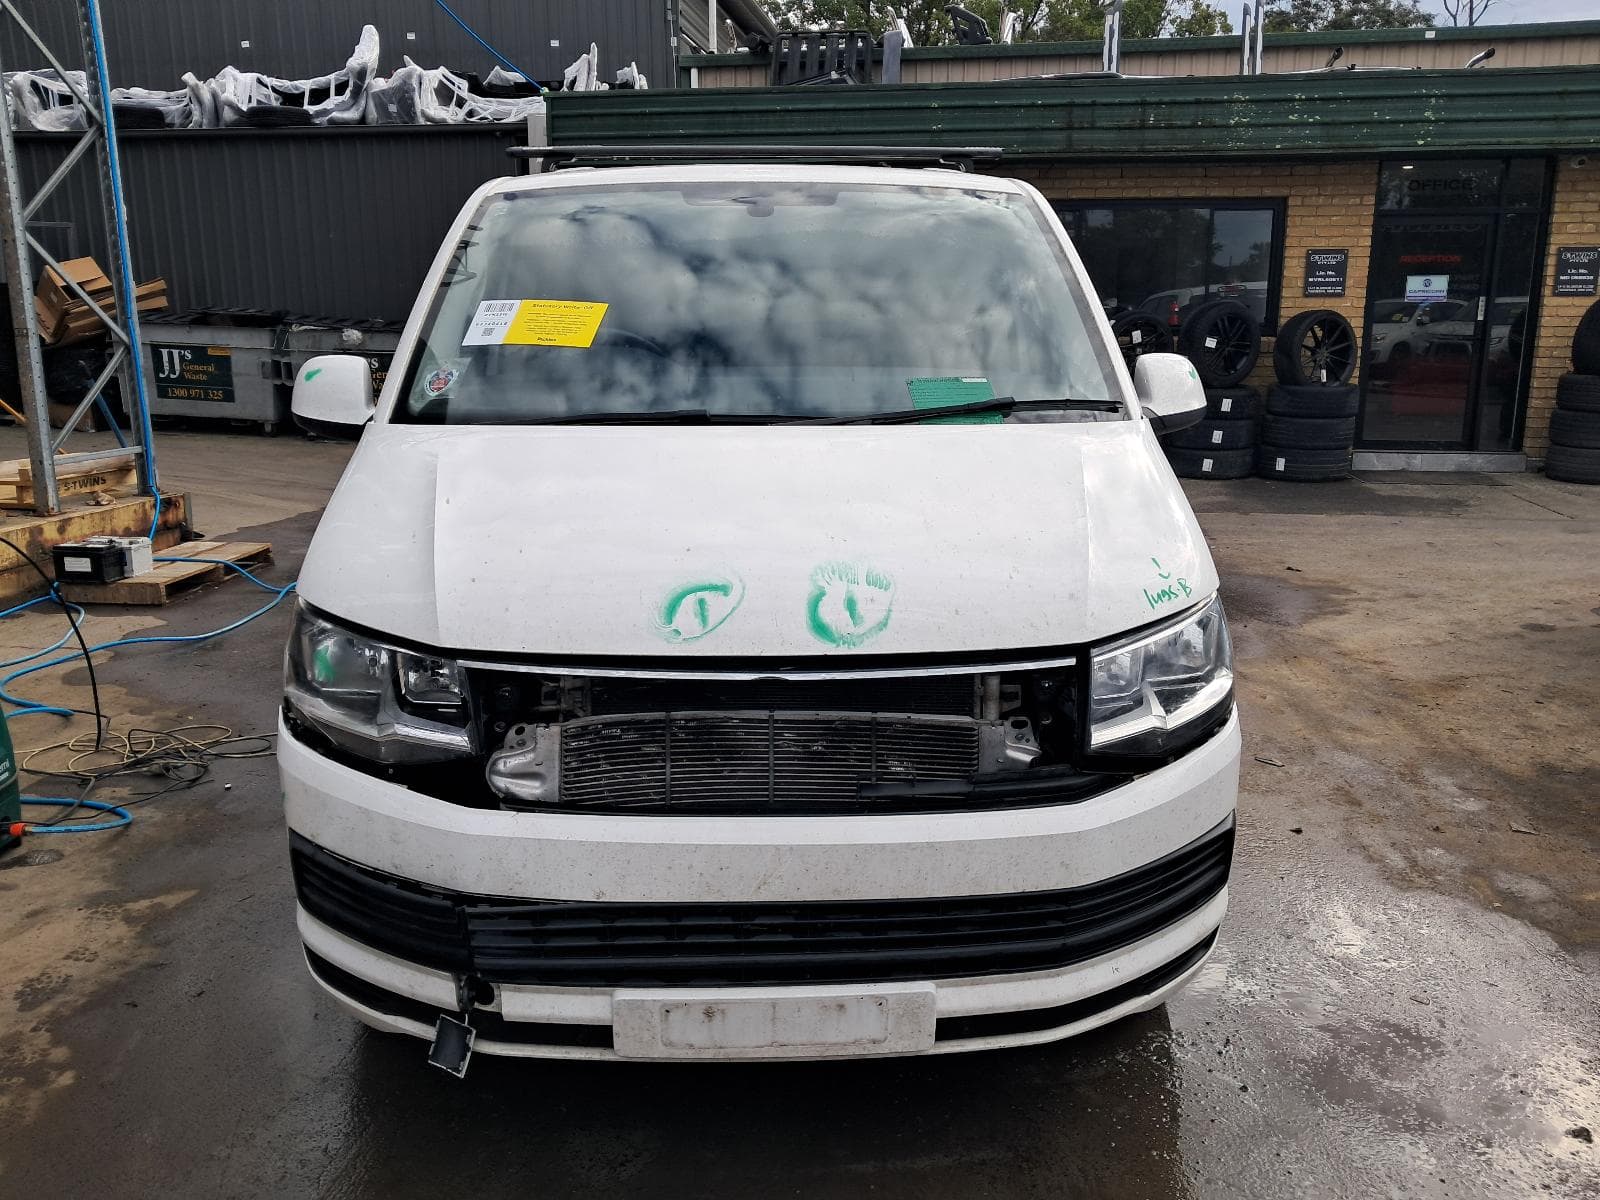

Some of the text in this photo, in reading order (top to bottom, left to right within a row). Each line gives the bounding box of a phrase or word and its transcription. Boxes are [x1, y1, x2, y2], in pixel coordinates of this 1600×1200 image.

[1408, 178, 1473, 192] OFFICE
[1399, 254, 1462, 264] RECEPTION
[182, 362, 215, 372] General
[183, 371, 208, 381] Waste
[167, 387, 224, 400] 1300 971 325
